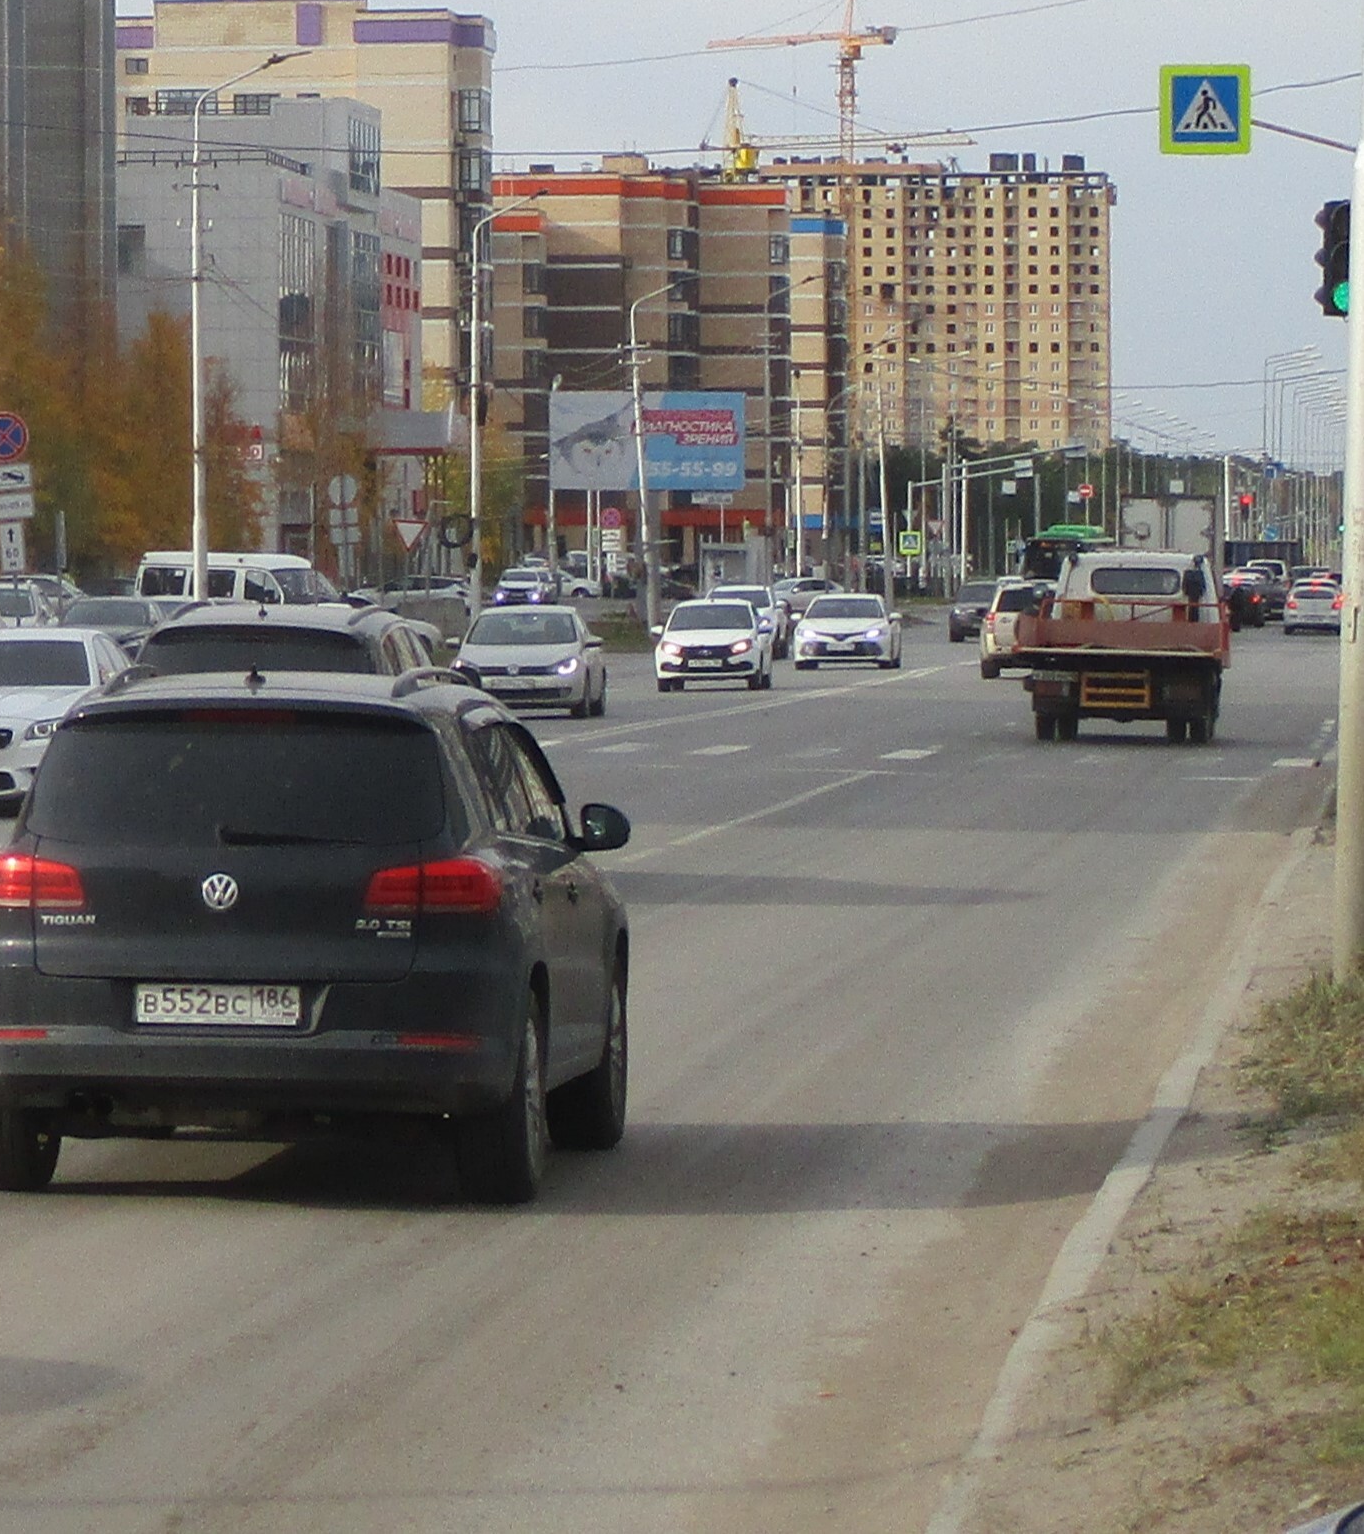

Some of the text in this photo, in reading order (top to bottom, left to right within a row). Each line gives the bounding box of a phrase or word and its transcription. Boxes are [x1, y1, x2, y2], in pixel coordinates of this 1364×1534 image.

[680, 432, 735, 445] ЗРЕНИЯ
[5, 546, 20, 559] 60
[40, 914, 97, 926] TIGUAN
[385, 919, 412, 931] TSI
